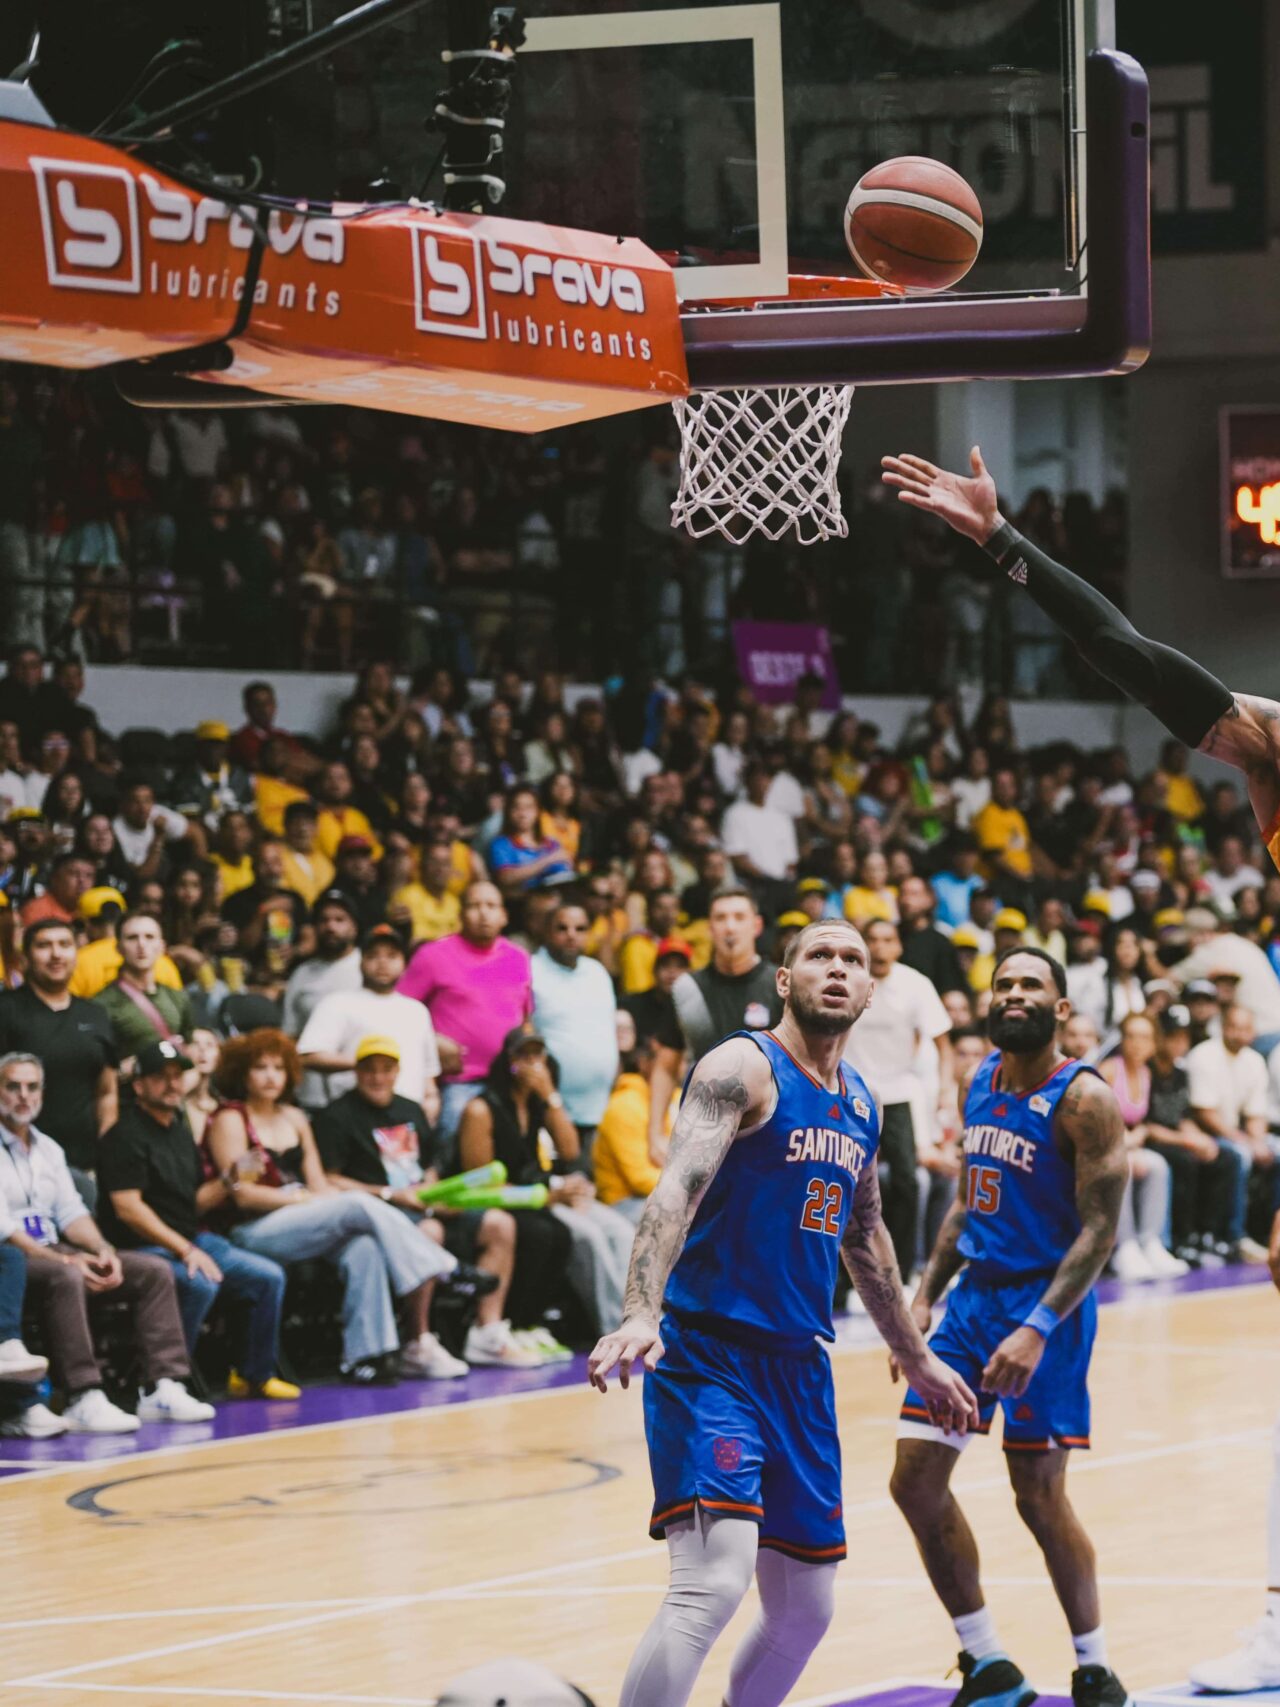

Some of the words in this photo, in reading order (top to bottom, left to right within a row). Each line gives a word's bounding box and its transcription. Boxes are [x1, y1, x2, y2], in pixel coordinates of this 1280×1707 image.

[150, 260, 340, 316] lubricants
[493, 310, 652, 360] lubricants
[786, 1128, 867, 1182] SANTURCE
[800, 1178, 843, 1237] 22
[967, 1164, 1002, 1215] 15
